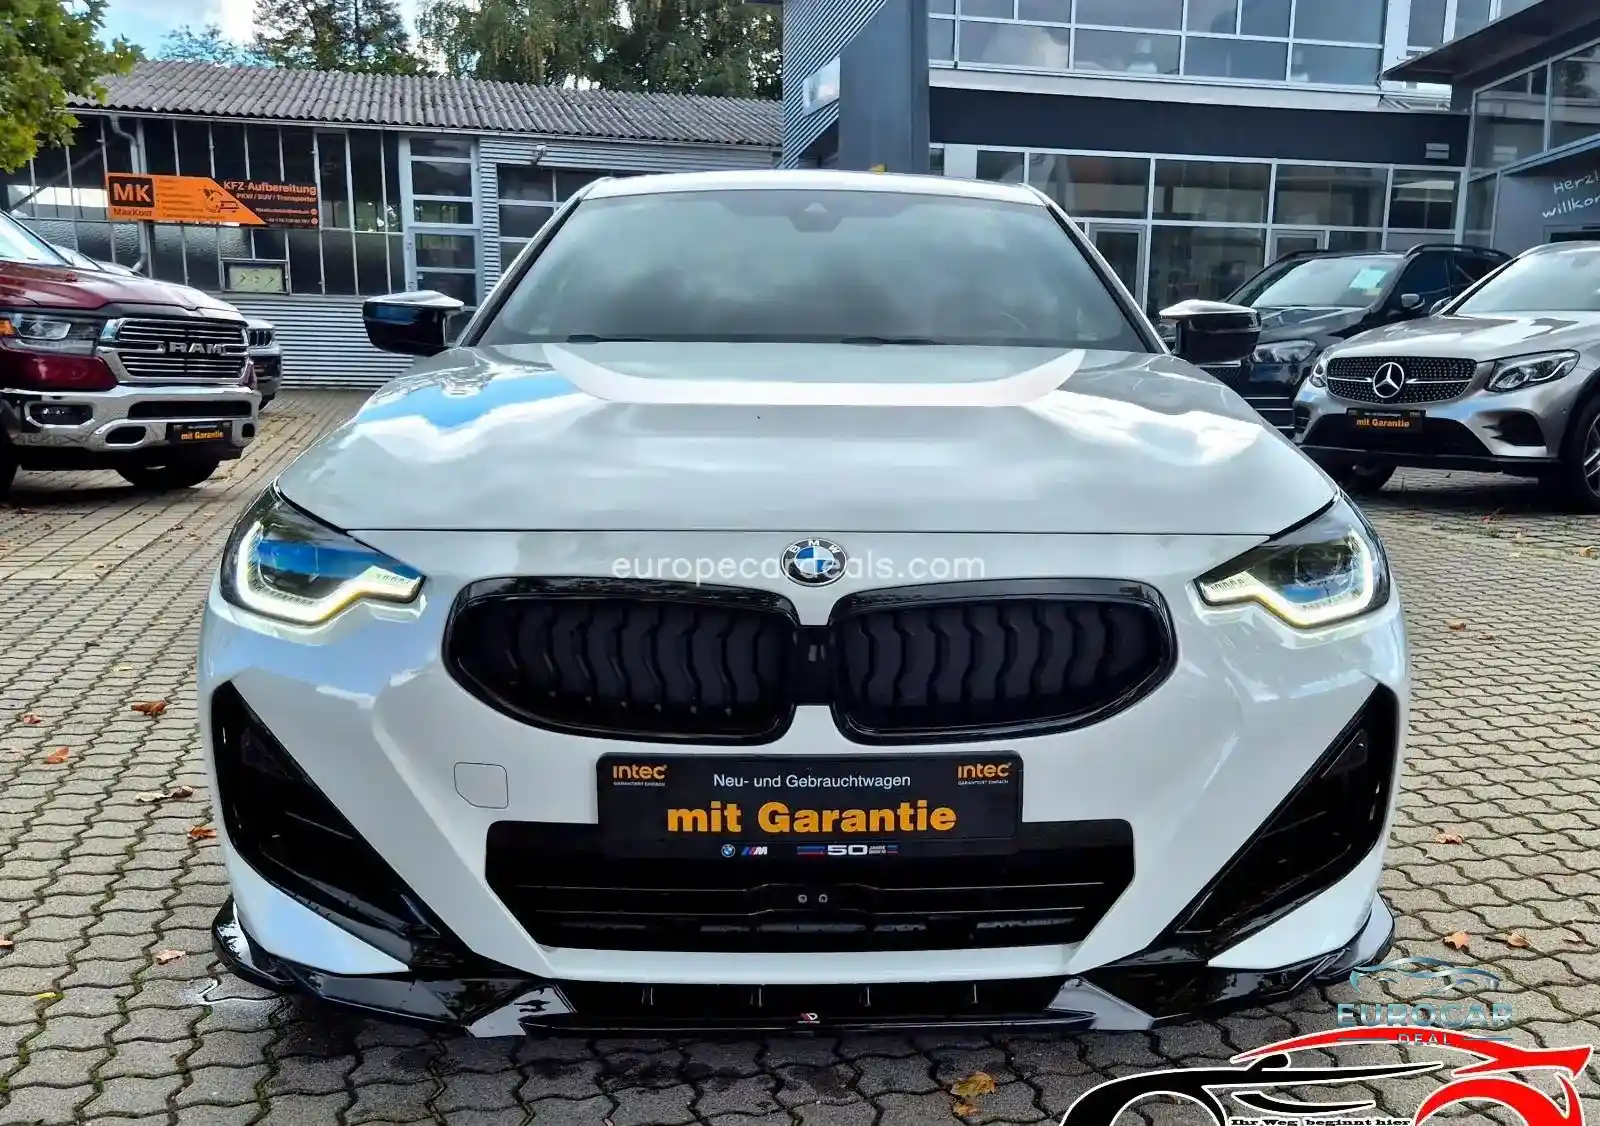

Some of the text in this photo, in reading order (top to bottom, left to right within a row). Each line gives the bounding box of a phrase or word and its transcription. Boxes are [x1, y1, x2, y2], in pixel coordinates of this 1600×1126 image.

[113, 183, 152, 202] MK
[169, 342, 222, 354] RAM
[1356, 418, 1410, 428] mit Garantie
[181, 431, 224, 440] mit Garantie
[789, 539, 841, 554] BMW
[613, 764, 666, 780] intec
[957, 762, 1010, 779] intec
[713, 773, 911, 790] Neu- und Gebrauchtwagen
[668, 800, 957, 833] mit Garantie
[827, 844, 868, 856] 50
